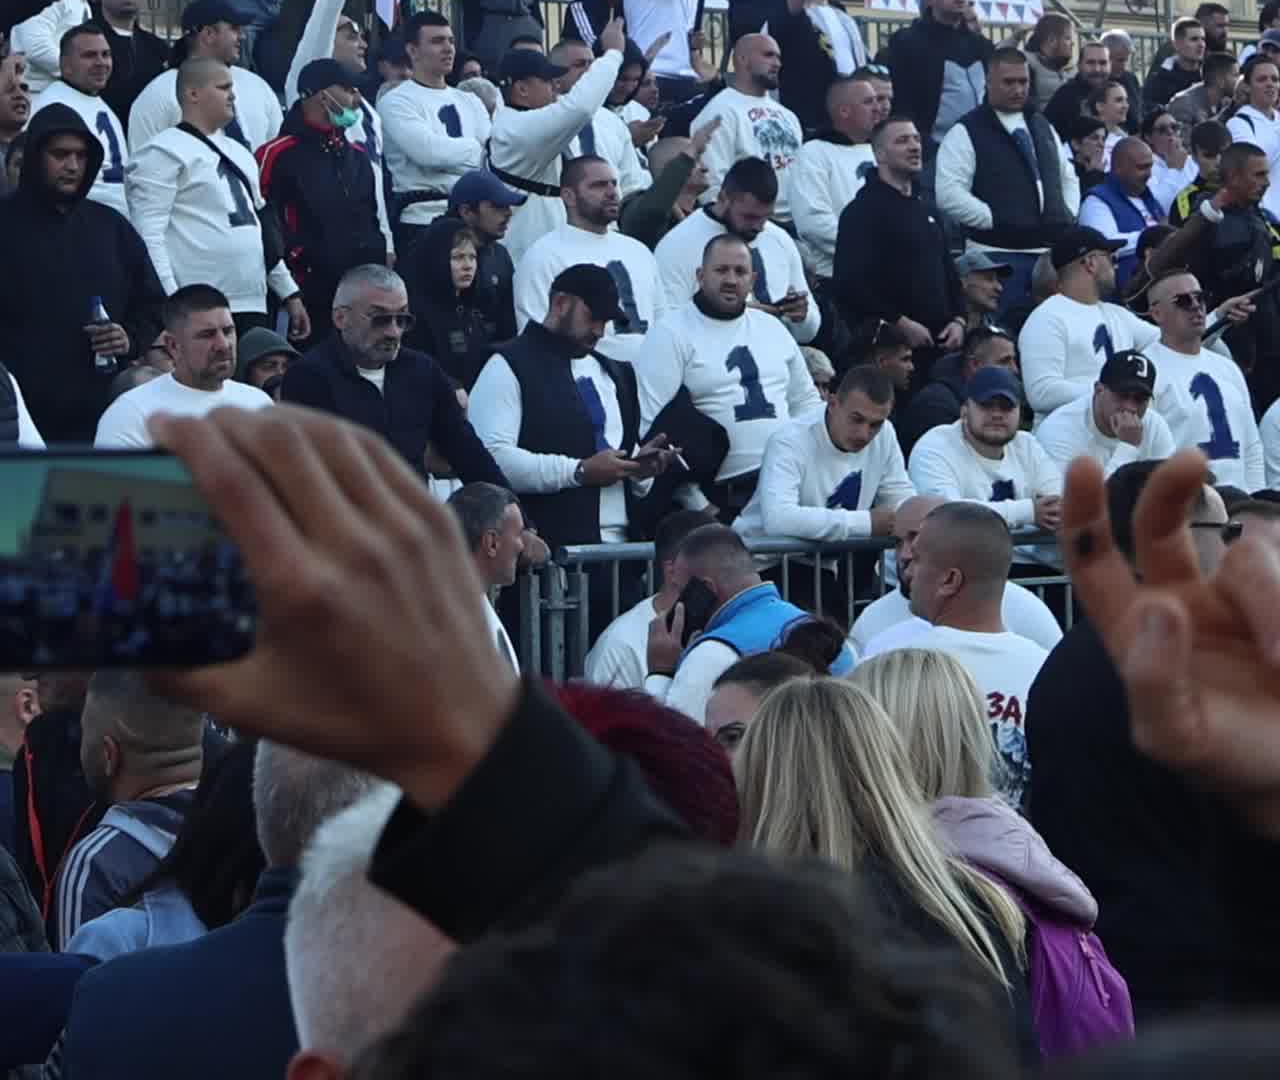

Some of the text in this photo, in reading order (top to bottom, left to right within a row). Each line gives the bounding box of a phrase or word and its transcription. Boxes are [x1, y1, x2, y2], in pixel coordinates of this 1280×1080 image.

[96, 110, 124, 183] 1
[725, 345, 777, 421] 1
[1190, 371, 1241, 460] 1
